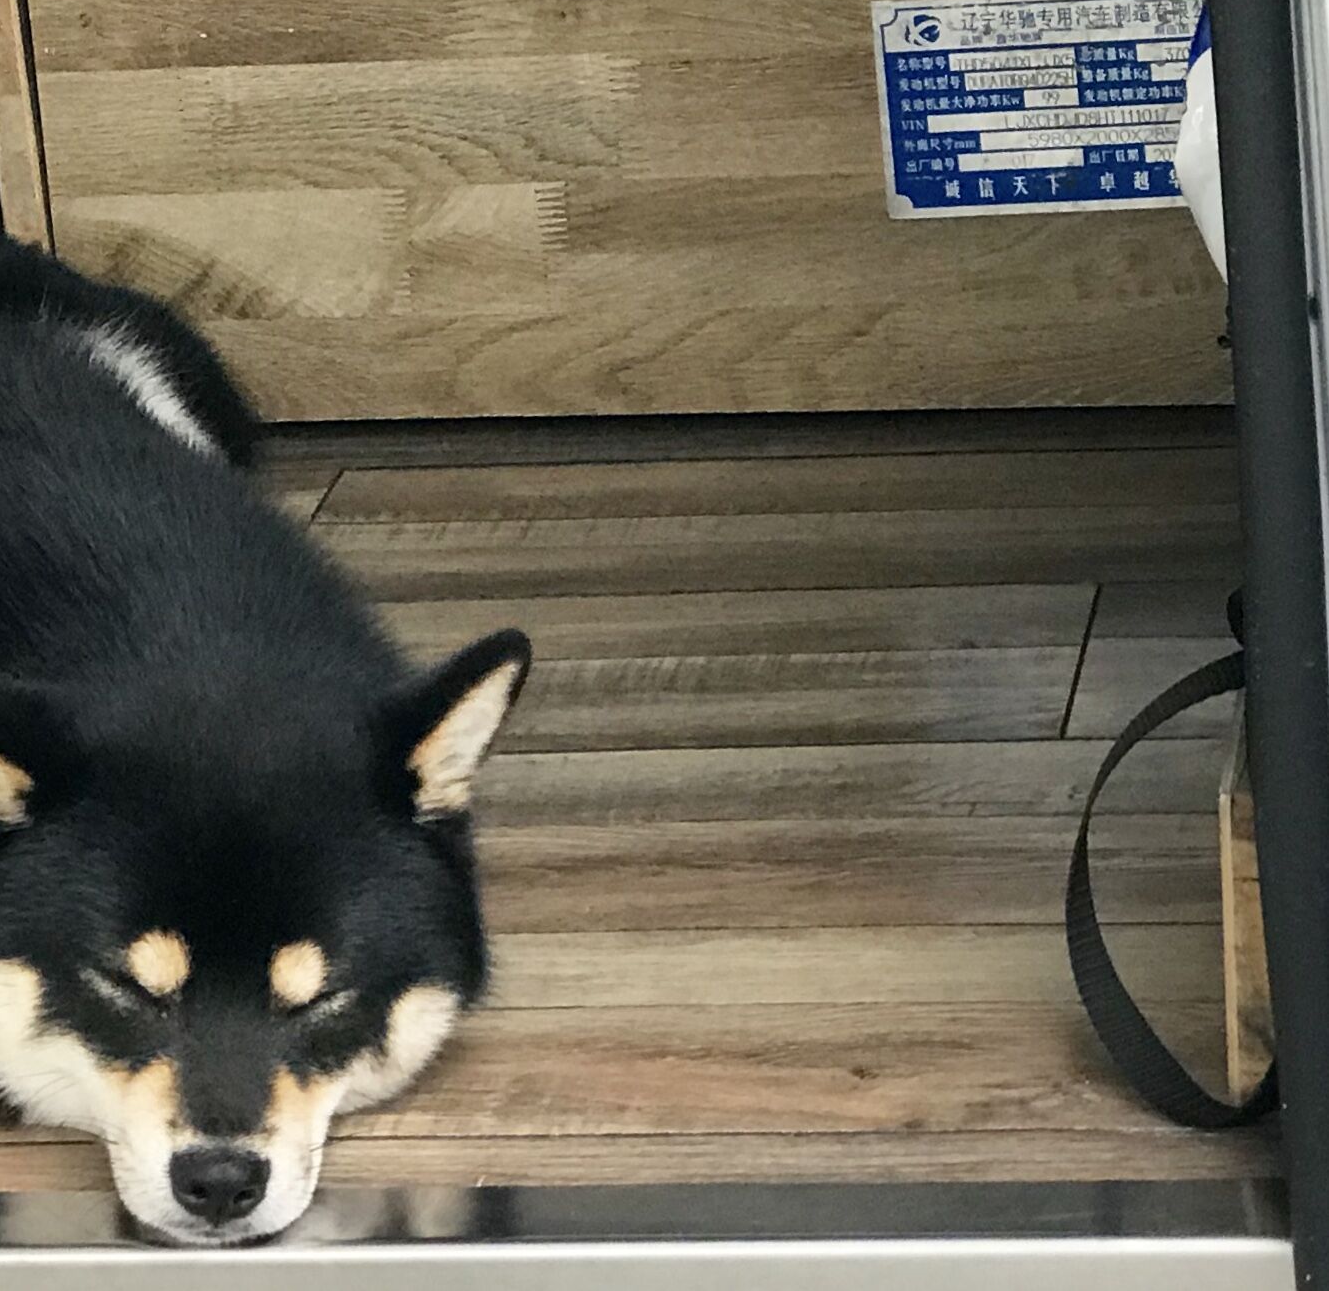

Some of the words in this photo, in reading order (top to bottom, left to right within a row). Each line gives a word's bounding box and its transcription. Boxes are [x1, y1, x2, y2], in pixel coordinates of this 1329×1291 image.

[901, 119, 925, 130] VIN
[1027, 126, 1179, 147] 5980X2000X285
[1153, 146, 1177, 162] 20
